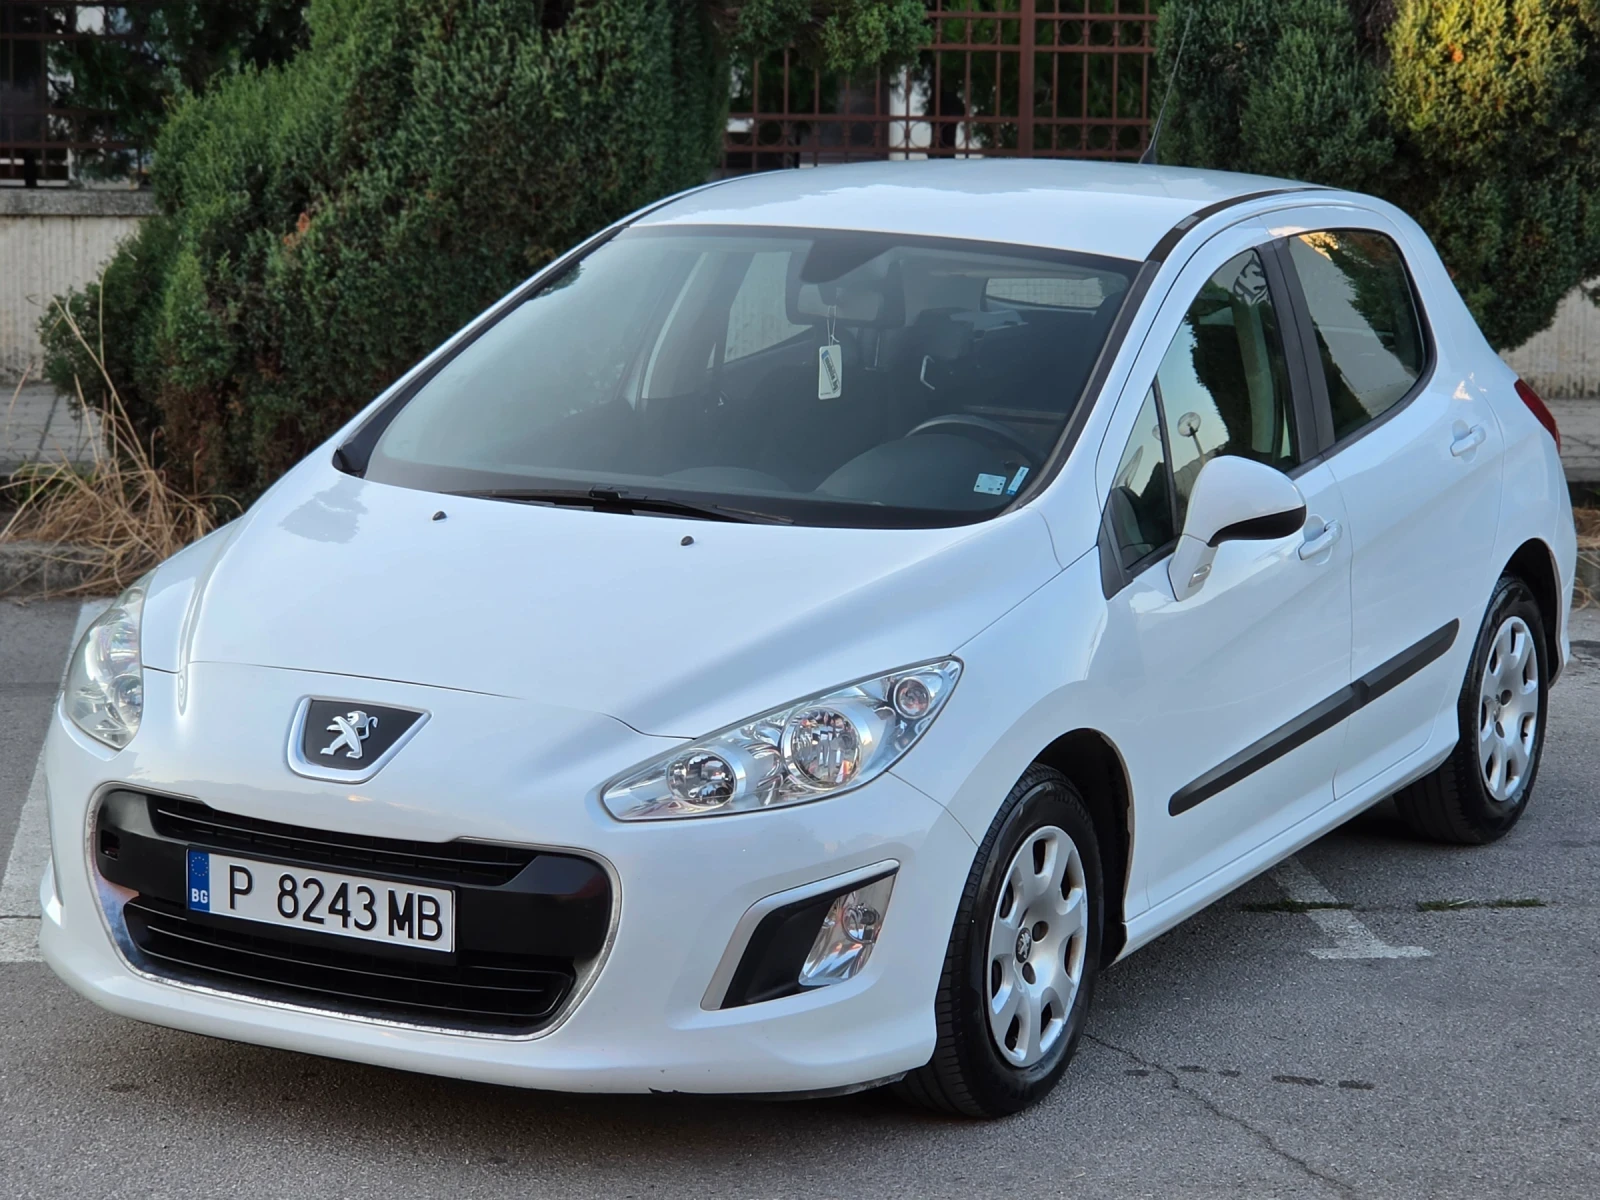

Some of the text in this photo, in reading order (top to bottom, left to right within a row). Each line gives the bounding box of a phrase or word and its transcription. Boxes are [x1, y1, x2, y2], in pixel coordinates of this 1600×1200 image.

[191, 888, 209, 904] BG
[229, 864, 443, 942] P 8243 MB
